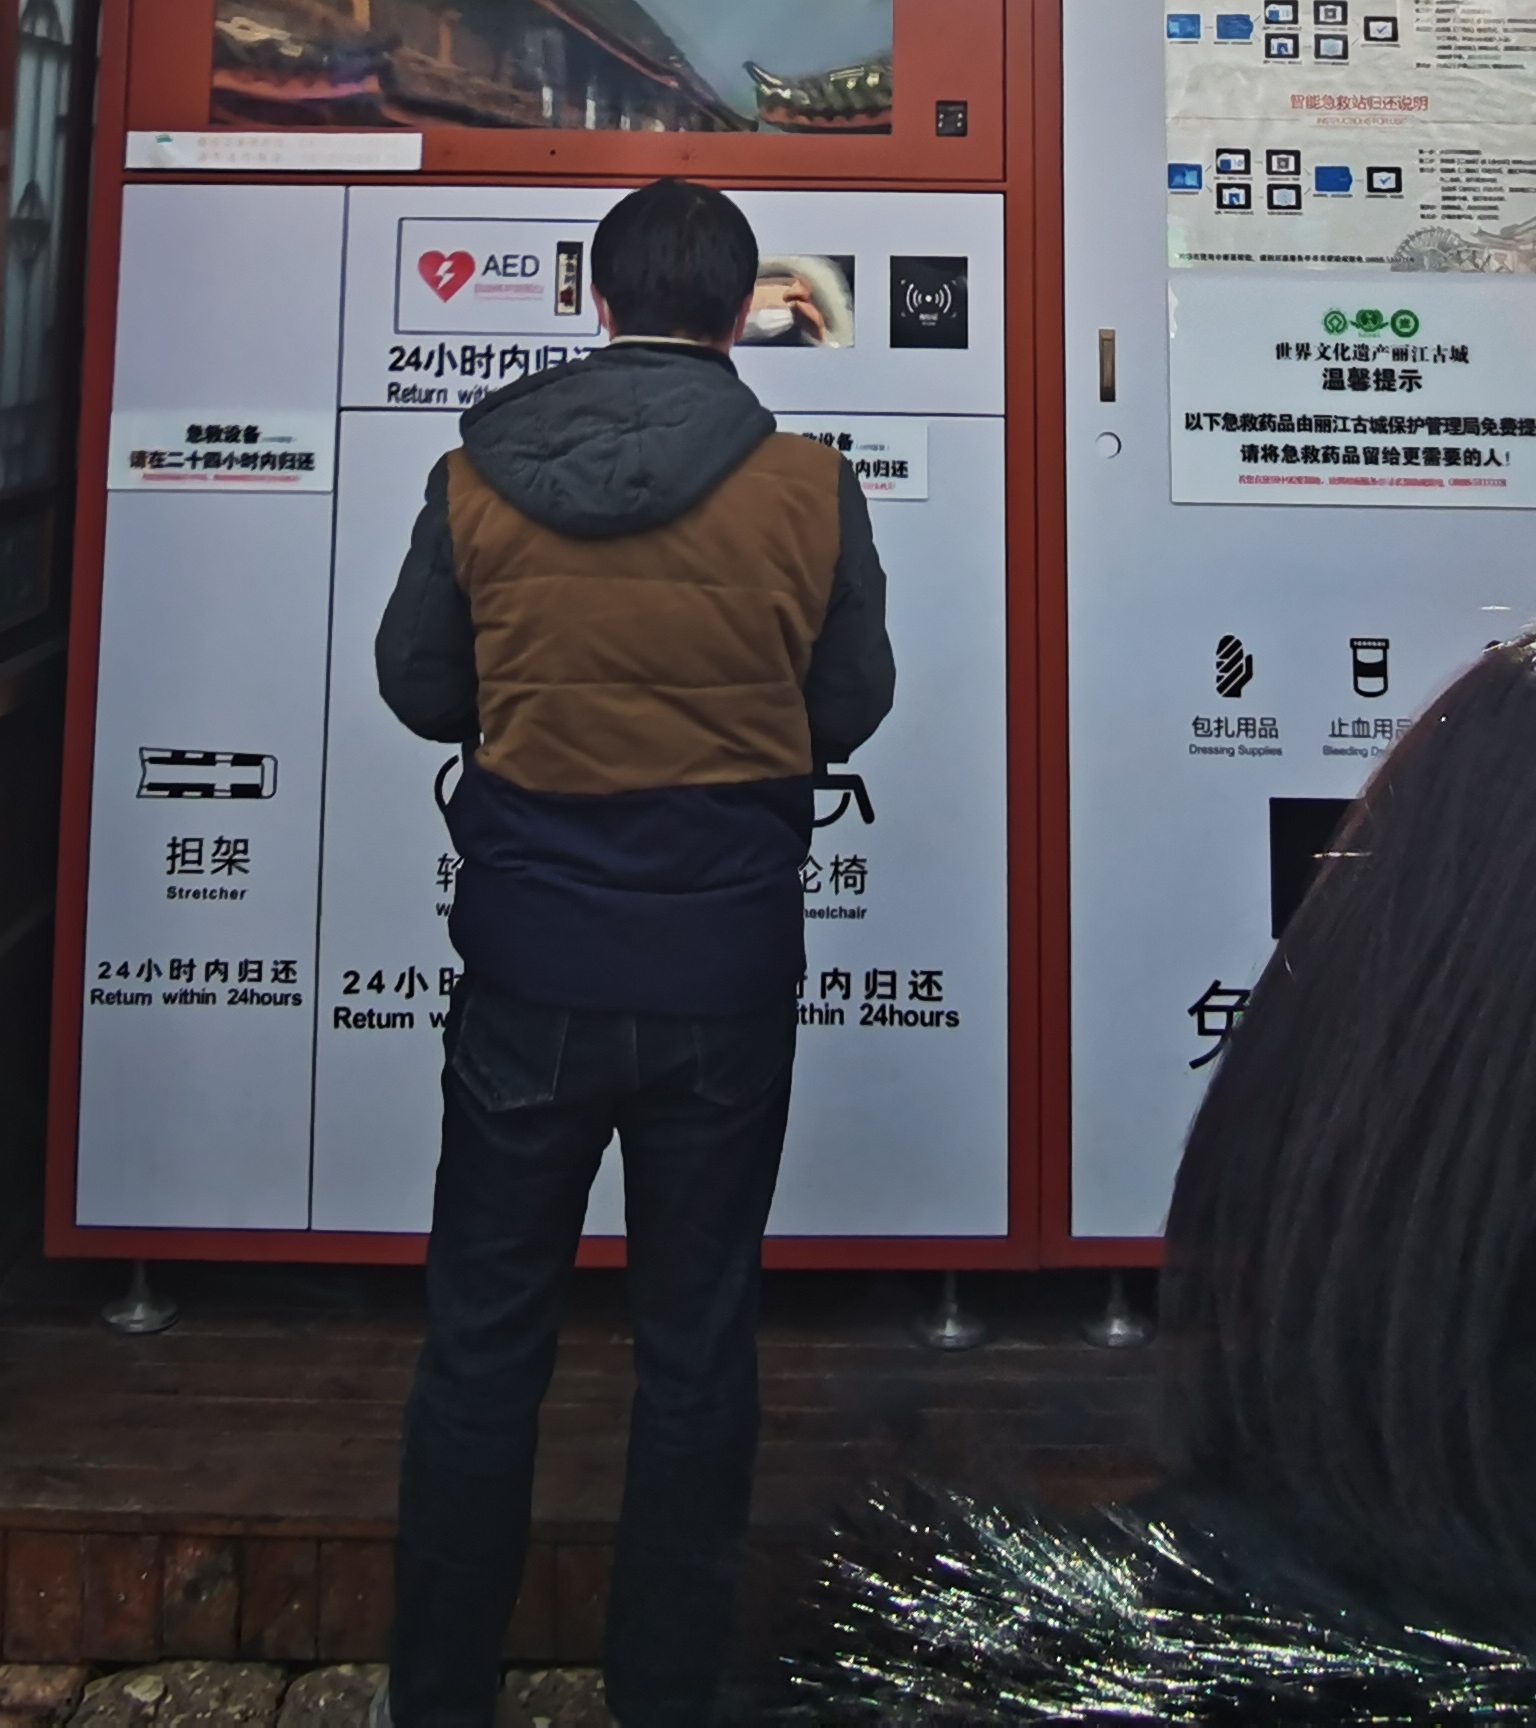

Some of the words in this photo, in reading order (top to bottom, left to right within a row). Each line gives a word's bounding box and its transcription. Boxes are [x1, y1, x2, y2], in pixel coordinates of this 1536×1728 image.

[1290, 94, 1429, 112] 智能急救站归还说明
[481, 254, 540, 278] AED
[387, 342, 602, 379] 24小时内归
[1275, 342, 1470, 365] 世界文化遗产丽江古城
[1322, 367, 1423, 393] 温馨提示
[386, 381, 448, 404] Return
[130, 450, 316, 471] 请在二十四小时内归还
[1192, 715, 1279, 740] 包扎用品
[1189, 744, 1235, 757] Dressing
[1238, 744, 1283, 757] Supplies
[1322, 744, 1368, 758] Bleeding
[165, 835, 252, 876] 担架
[166, 885, 247, 901] Stretcher
[98, 958, 298, 985] 24小时内归还
[162, 987, 217, 1006] within
[227, 988, 303, 1007] 24hours
[797, 1002, 845, 1026] ithin
[859, 1003, 960, 1028] 24hours
